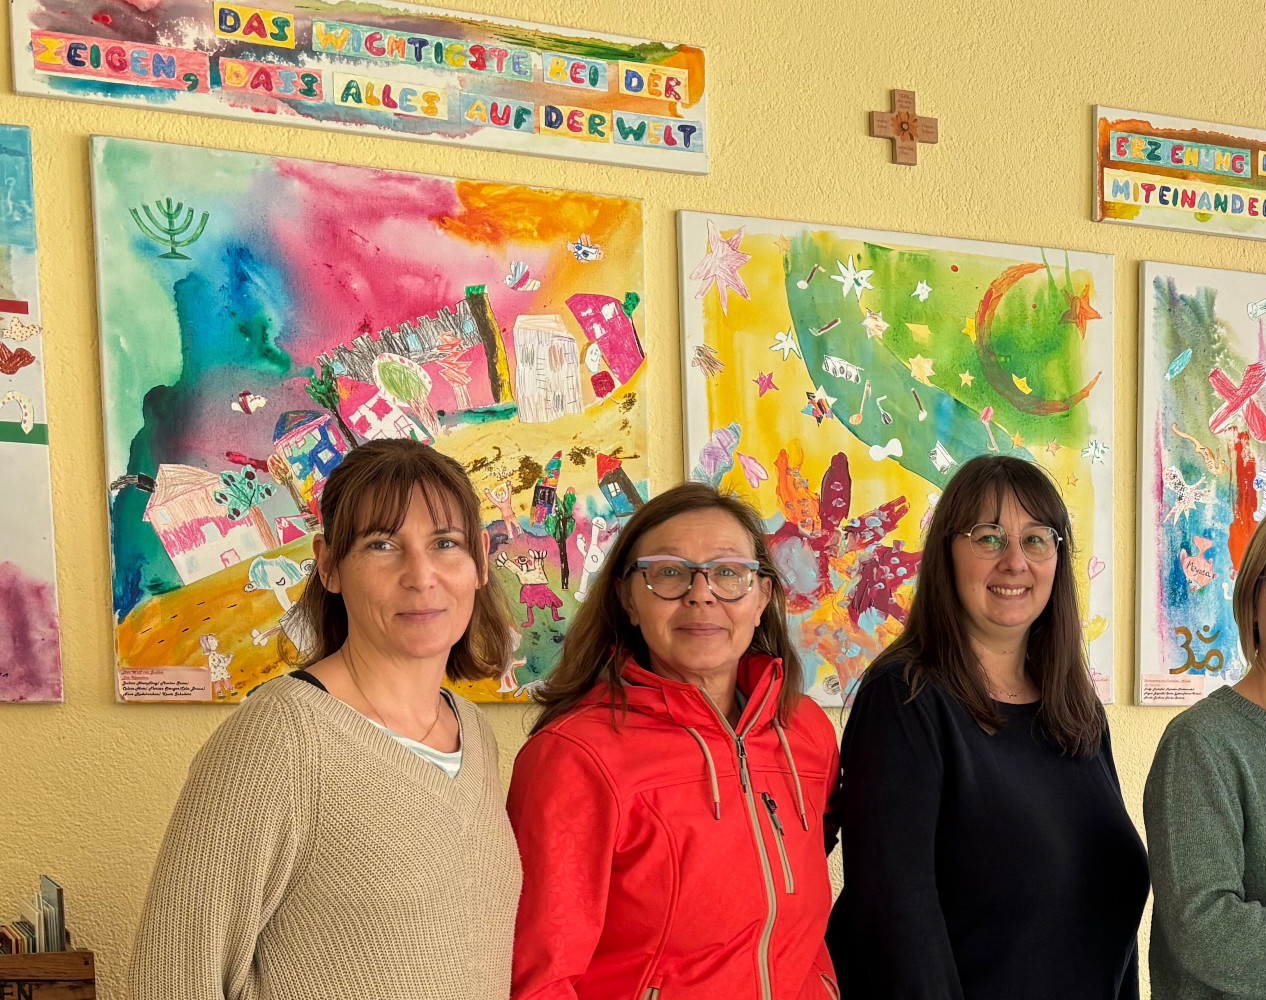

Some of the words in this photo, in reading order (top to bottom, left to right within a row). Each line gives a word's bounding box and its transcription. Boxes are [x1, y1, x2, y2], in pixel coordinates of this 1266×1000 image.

[36, 37, 199, 92] ZEIGEN,
[225, 60, 319, 98] DASS
[340, 79, 441, 117] ALLES
[466, 100, 532, 130] AUF
[544, 105, 606, 138] DER
[616, 116, 697, 148] WELT
[218, 7, 291, 42] DAS
[315, 22, 530, 76] WICHTIGSTE
[549, 57, 600, 88] BEI
[624, 69, 682, 101] DER
[1116, 136, 1246, 174] ERZIEHUNG
